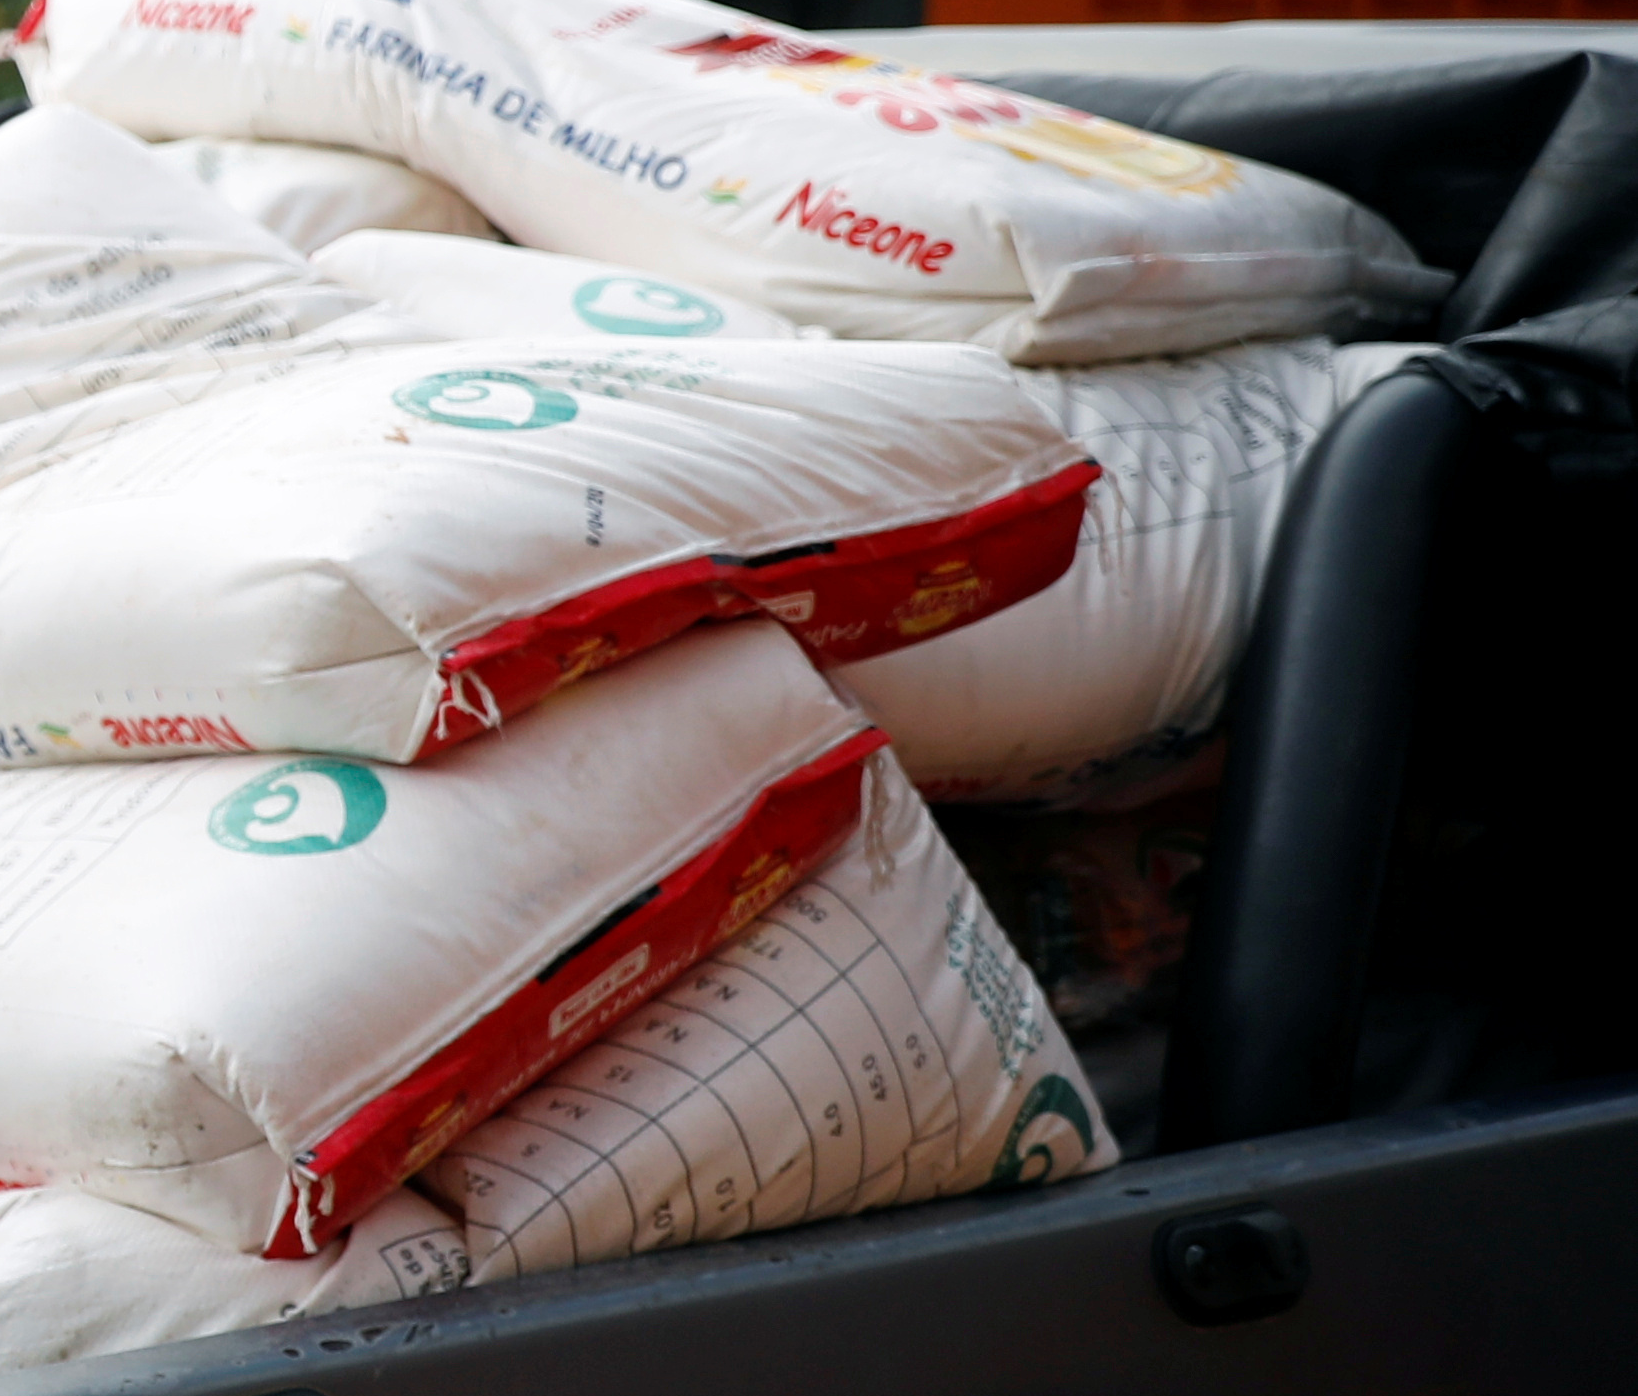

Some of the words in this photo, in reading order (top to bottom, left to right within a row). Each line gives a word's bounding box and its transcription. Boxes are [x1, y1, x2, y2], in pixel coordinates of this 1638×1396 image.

[326, 17, 483, 100] FARINHA
[493, 87, 545, 137] DE
[550, 119, 688, 191] MILHO
[776, 180, 954, 275] Niceone
[100, 713, 258, 753] Niceone
